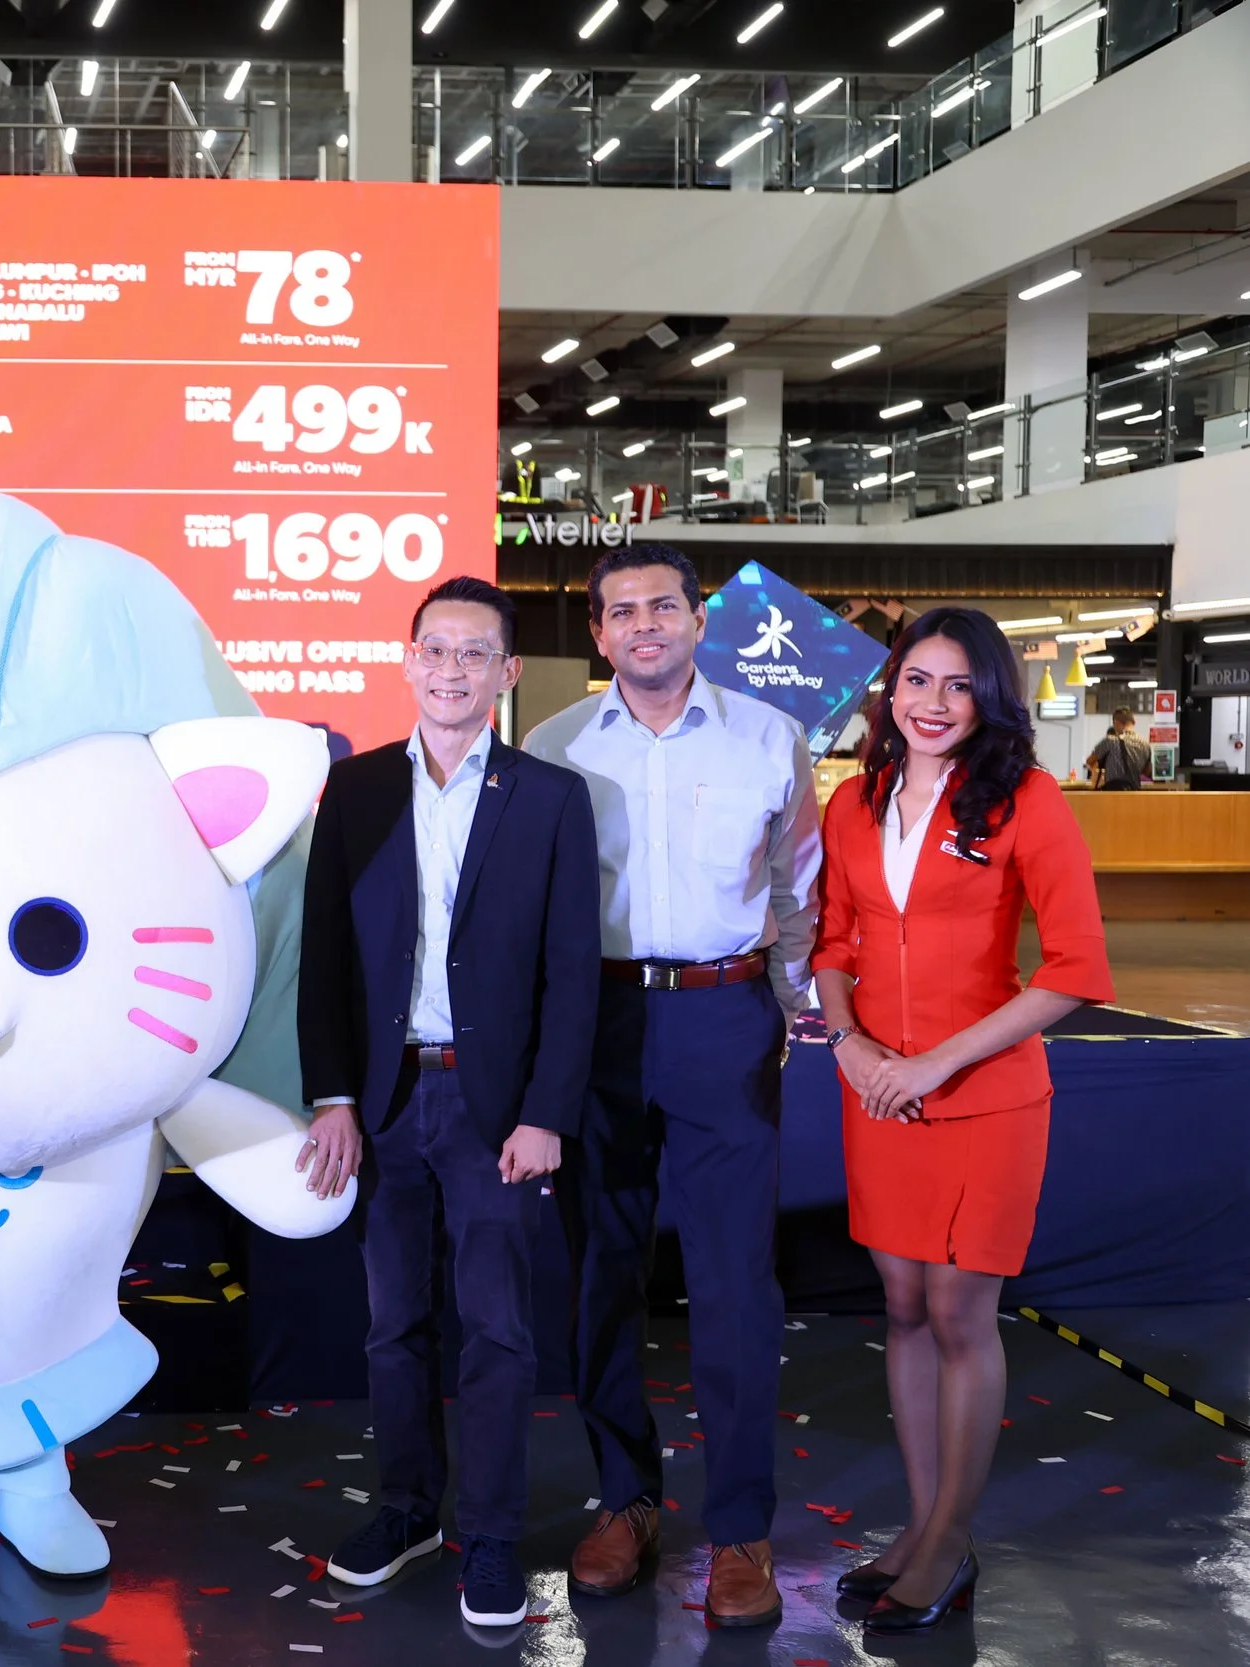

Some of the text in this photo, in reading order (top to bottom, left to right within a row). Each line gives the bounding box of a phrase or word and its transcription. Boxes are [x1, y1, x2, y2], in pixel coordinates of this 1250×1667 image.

[92, 264, 146, 282] IPOH
[185, 267, 237, 287] MYR
[19, 283, 120, 302] KUCHING
[305, 334, 331, 346] One
[332, 335, 360, 348] Way
[185, 401, 232, 422] IDR
[303, 462, 331, 475] One
[332, 462, 362, 477] Way
[302, 588, 330, 602] One
[331, 589, 362, 604] Way
[306, 640, 405, 663] OFFERS
[736, 661, 799, 674] Gardens
[299, 670, 366, 693] PASS
[748, 673, 823, 689] by the Bay
[1205, 668, 1250, 686] WORLD
